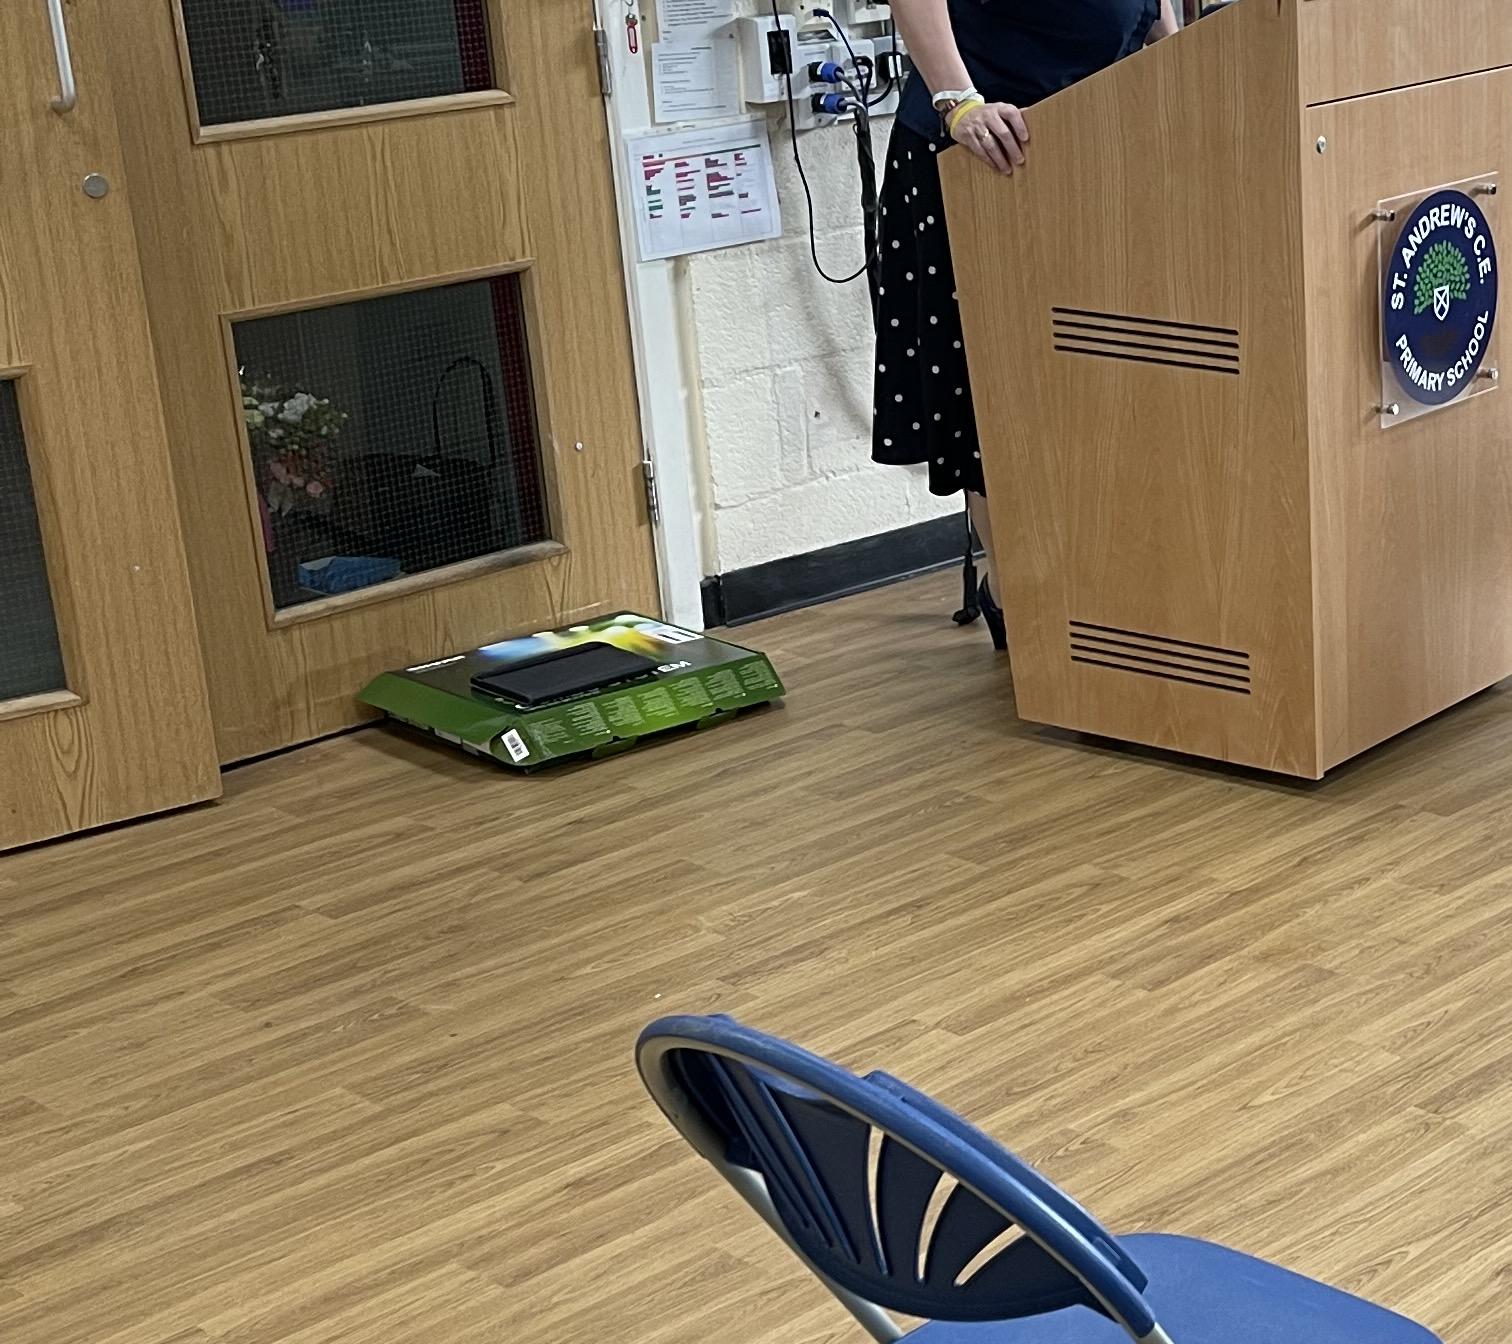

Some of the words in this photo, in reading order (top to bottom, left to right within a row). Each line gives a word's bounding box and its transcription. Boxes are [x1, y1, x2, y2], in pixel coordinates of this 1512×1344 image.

[1391, 272, 1408, 310] ST.
[1401, 204, 1477, 269] ANDREW'S
[1473, 234, 1492, 285] C.E.
[1395, 334, 1445, 392] PRIMARY
[1446, 310, 1489, 388] SCHOOL
